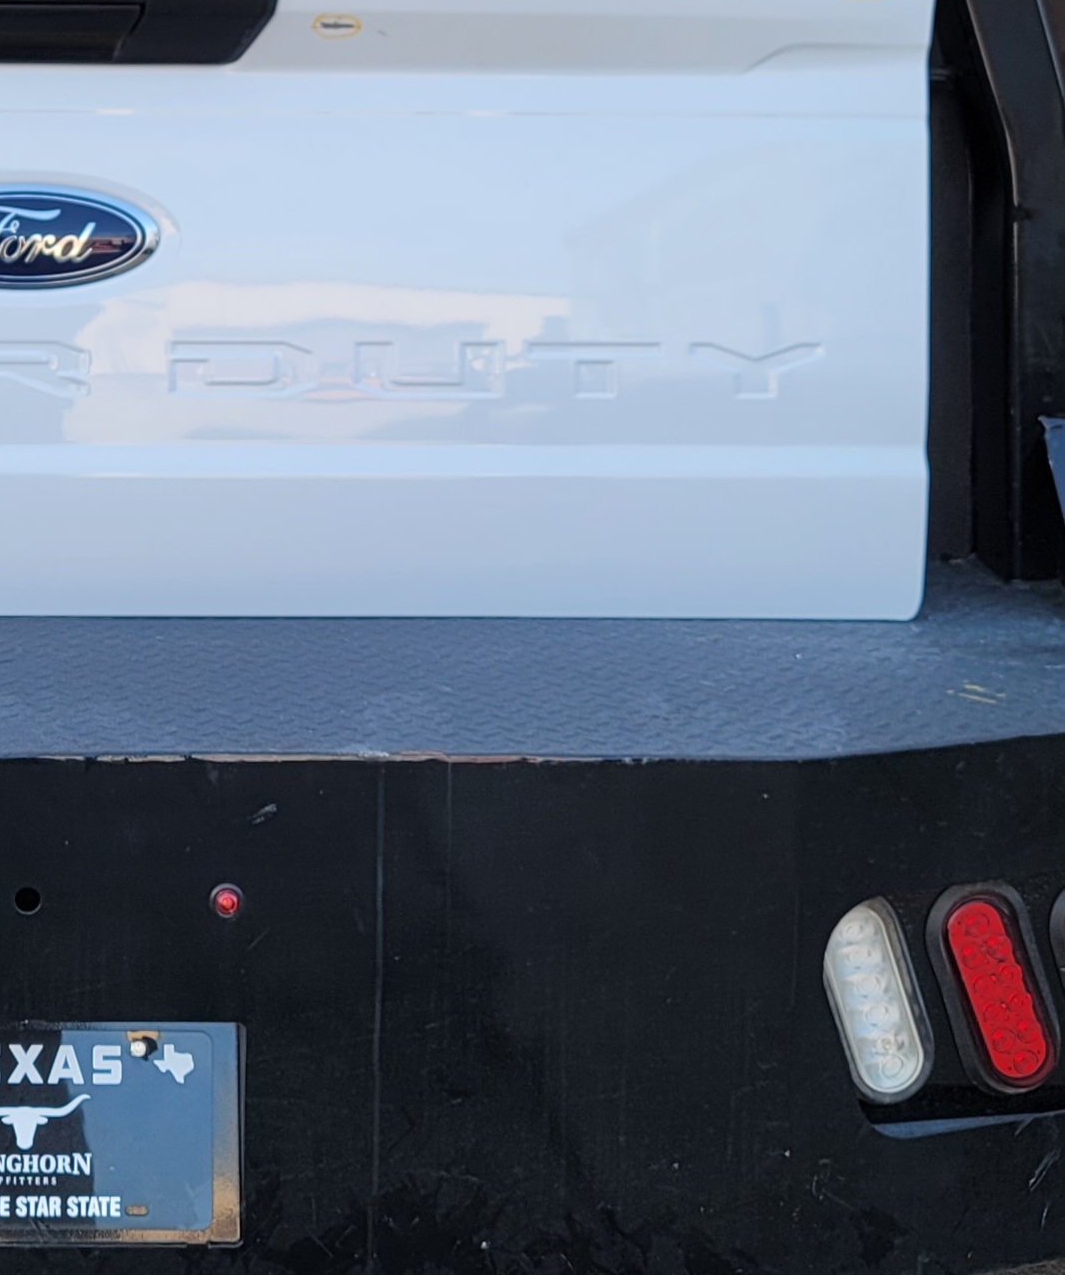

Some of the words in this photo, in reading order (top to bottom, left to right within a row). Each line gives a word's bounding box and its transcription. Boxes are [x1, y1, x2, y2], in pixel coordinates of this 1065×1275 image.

[168, 339, 826, 400] DUTY
[15, 1195, 62, 1217] STAR
[66, 1196, 122, 1218] STATE
